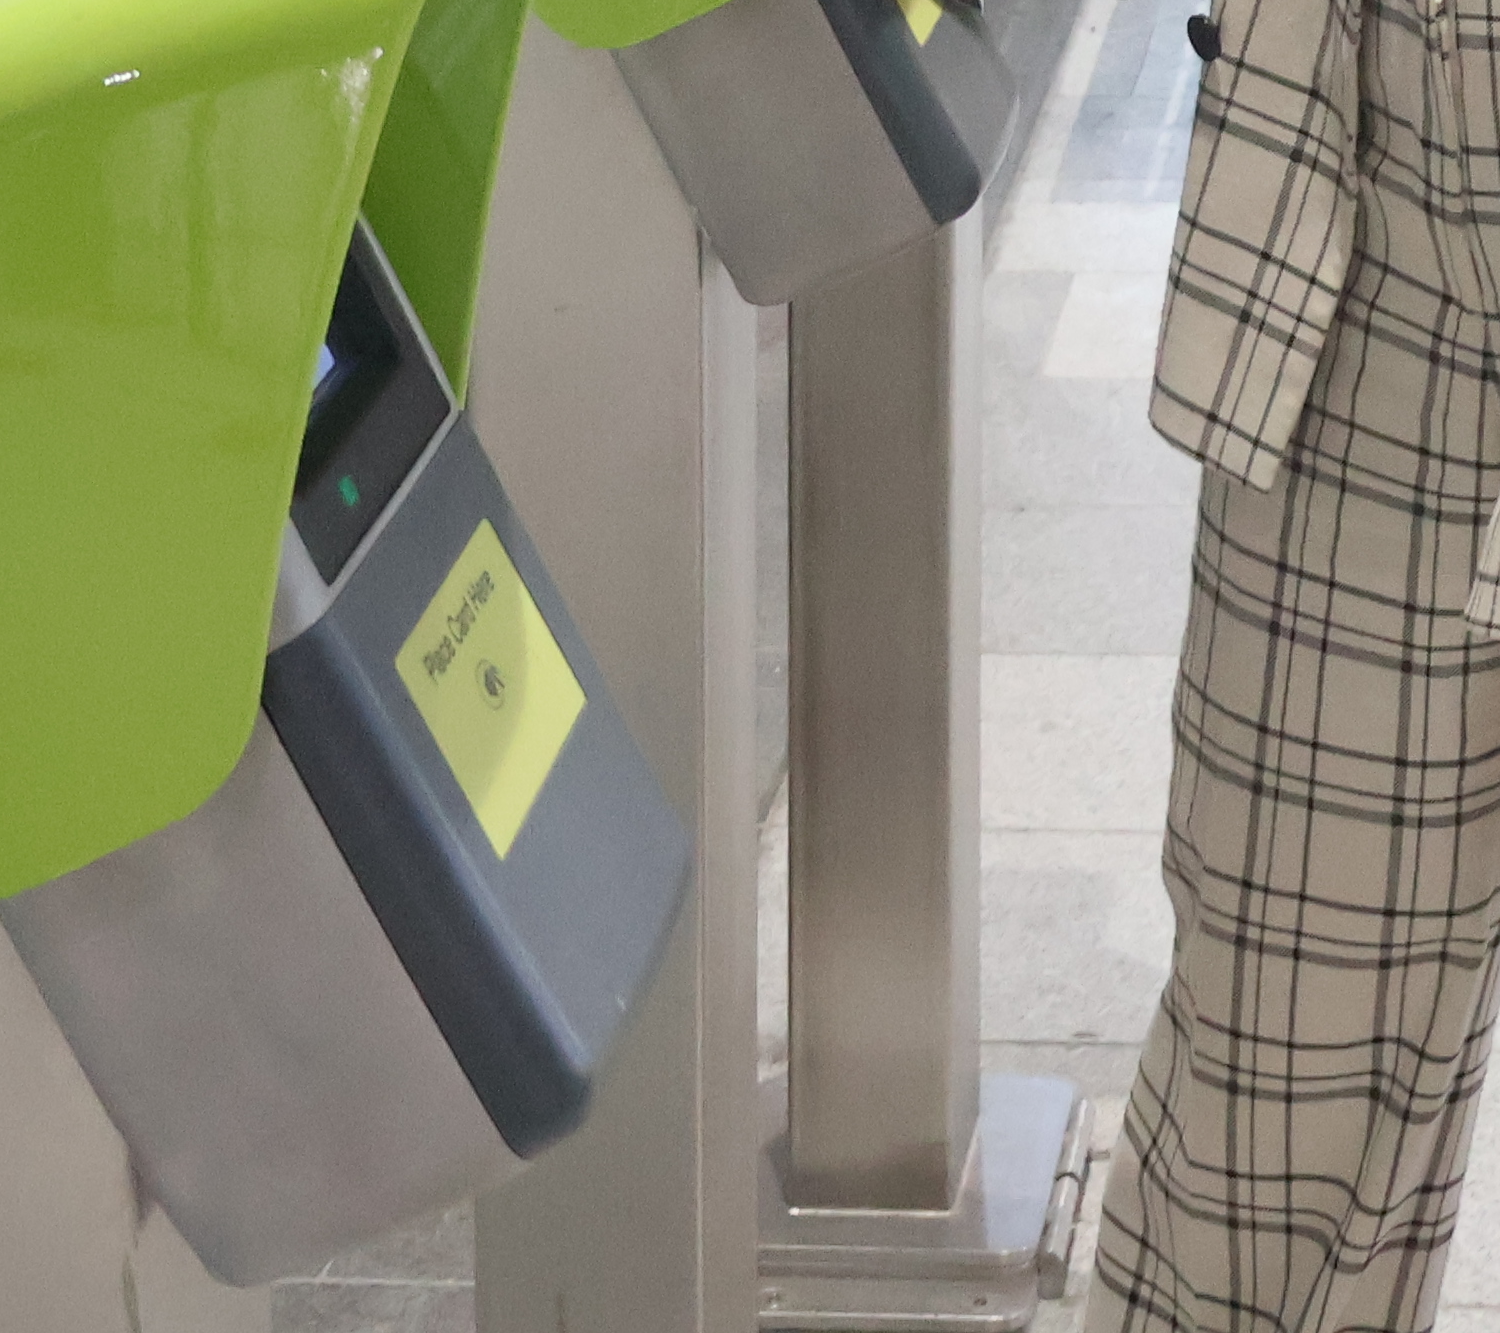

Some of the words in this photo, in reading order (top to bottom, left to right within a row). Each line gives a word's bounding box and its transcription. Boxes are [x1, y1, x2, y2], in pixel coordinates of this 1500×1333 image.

[423, 635, 456, 686] Place
[447, 596, 477, 645] Card
[467, 570, 495, 611] Here
